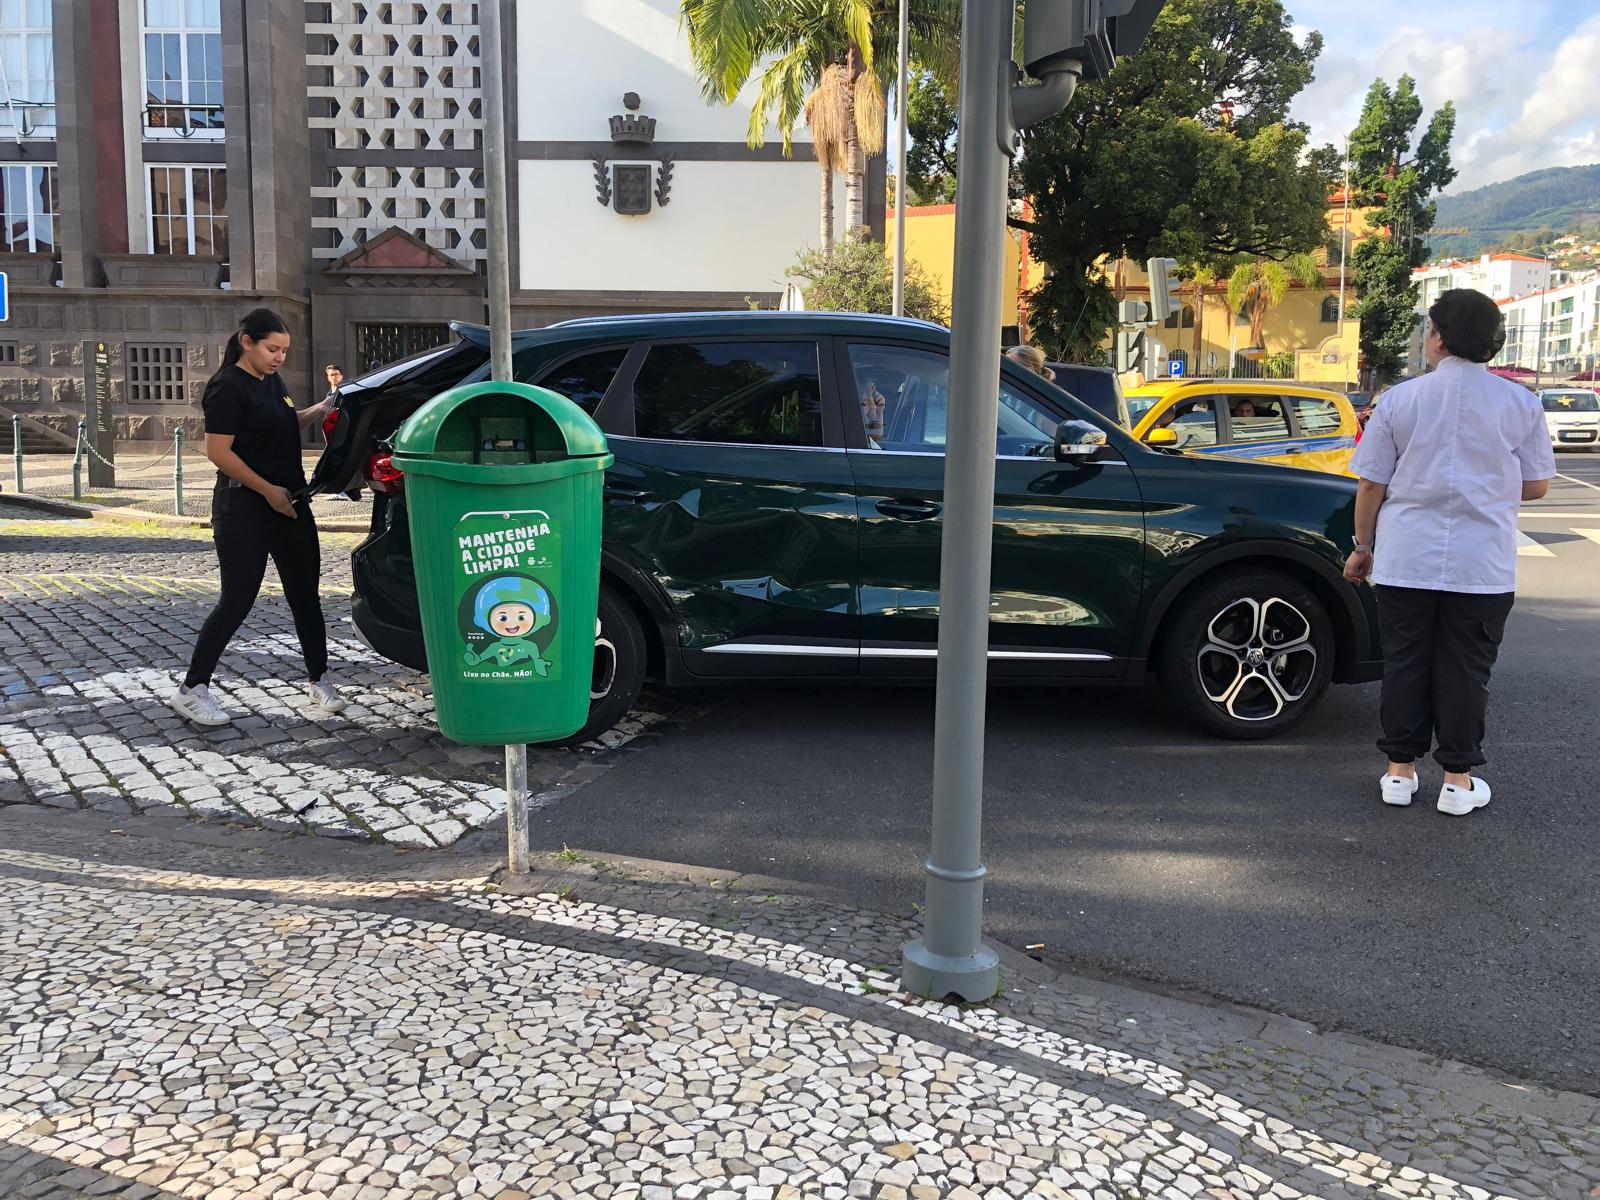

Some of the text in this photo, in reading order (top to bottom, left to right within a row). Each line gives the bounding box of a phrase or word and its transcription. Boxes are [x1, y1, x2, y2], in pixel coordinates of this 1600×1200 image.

[1172, 362, 1180, 374] P
[458, 522, 551, 549] MANTENHA
[462, 538, 536, 562] A CIDADE
[463, 554, 520, 575] LIMPA!
[463, 670, 479, 678] Lixo
[513, 669, 533, 677] NÃO!
